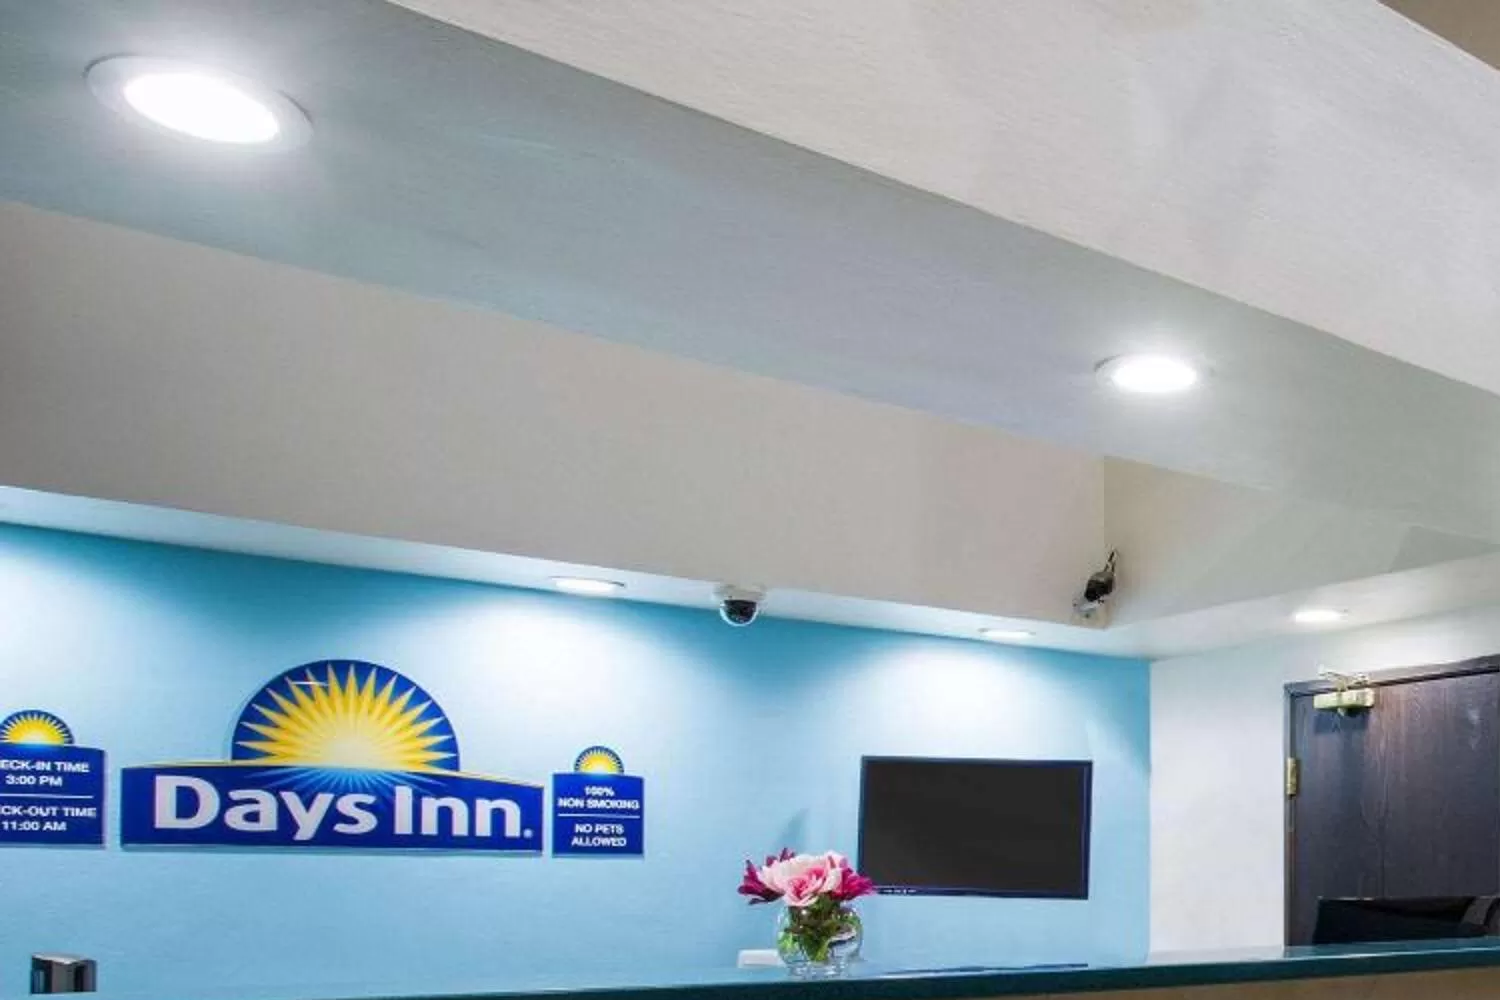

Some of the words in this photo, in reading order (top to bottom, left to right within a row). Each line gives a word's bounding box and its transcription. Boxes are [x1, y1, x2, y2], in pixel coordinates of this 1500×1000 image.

[0, 760, 51, 771] ECK-IN
[54, 762, 90, 773] TIME
[5, 774, 37, 785] 3:00
[39, 776, 63, 787] PM
[154, 775, 378, 841] Days
[558, 798, 585, 808] NON
[586, 799, 640, 810] SMOKING
[0, 805, 60, 817] CK-OUT
[62, 807, 97, 818] TIME
[2, 821, 40, 831] 11:00
[42, 822, 67, 832] AM
[575, 824, 593, 833] NO
[594, 824, 625, 835] PETS
[571, 836, 627, 847] ALLOWED
